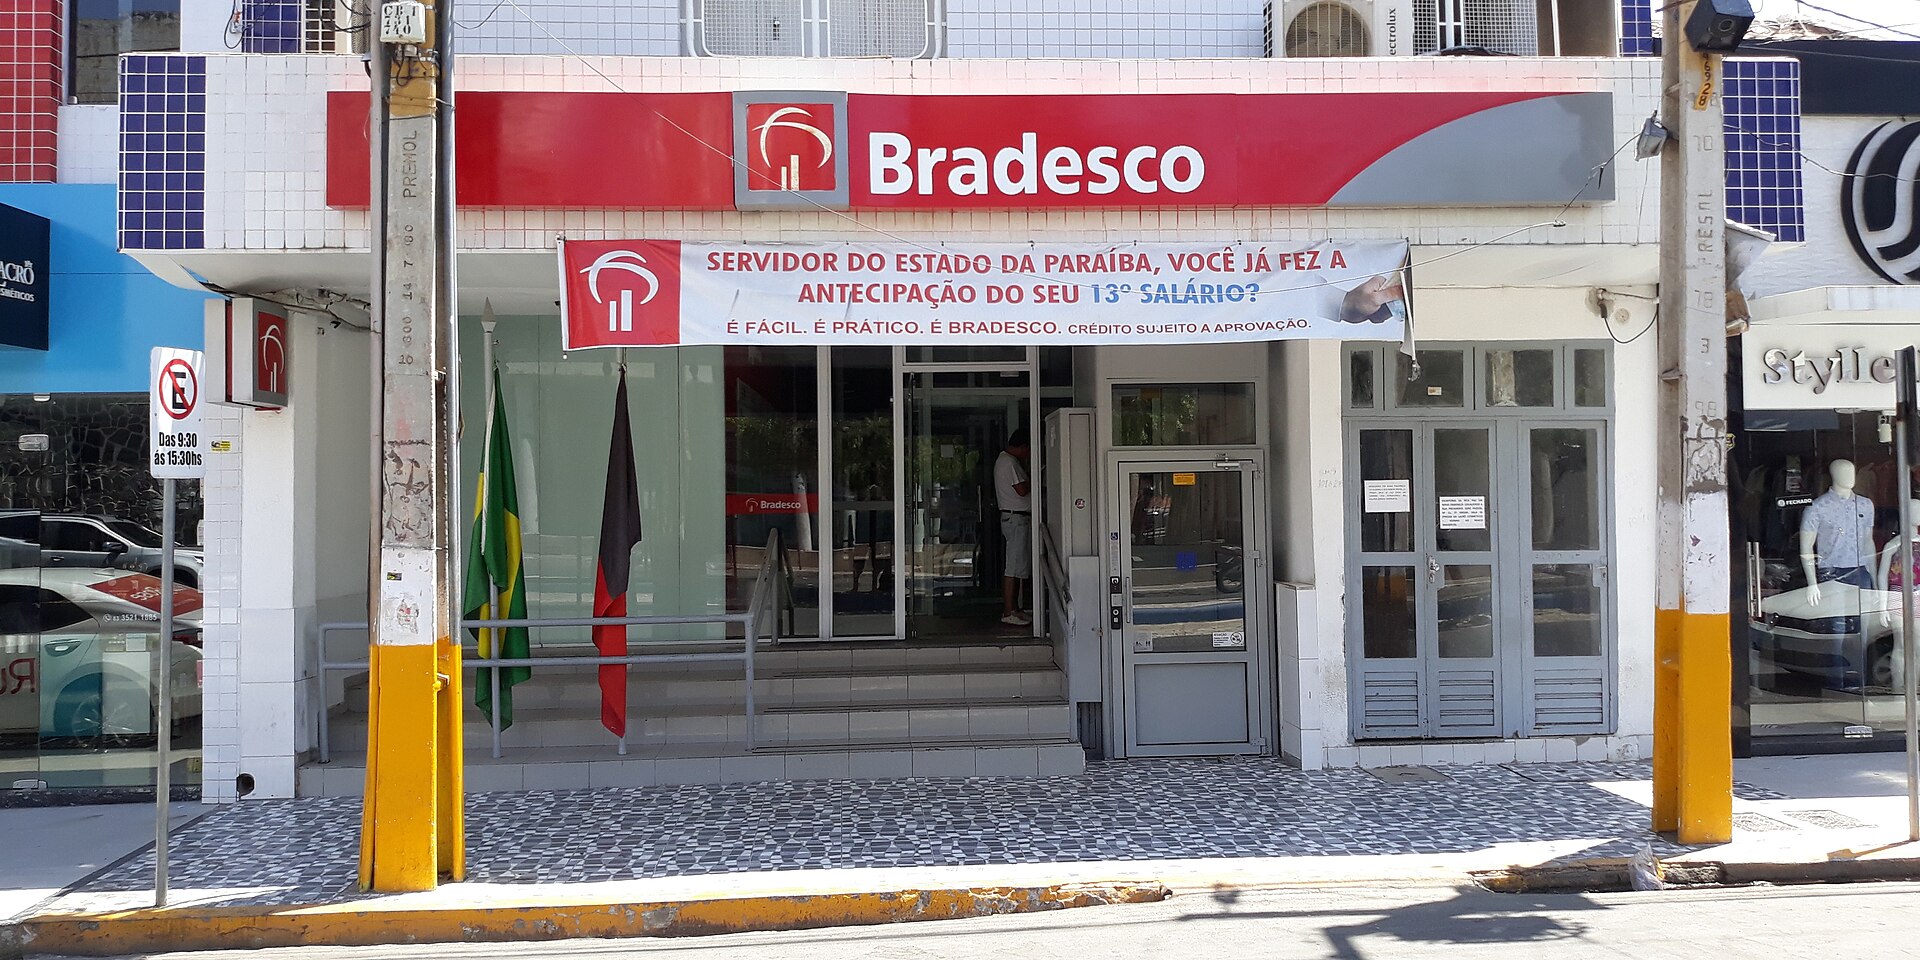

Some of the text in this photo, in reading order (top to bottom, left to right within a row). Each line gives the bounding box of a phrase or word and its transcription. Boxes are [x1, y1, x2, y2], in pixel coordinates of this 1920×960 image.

[1386, 8, 1397, 56] ectrolux
[869, 132, 1206, 196] Bradesco
[707, 246, 1348, 275] SERVIDOR DO ESTADO DA PARAÍBA, VOCÊ JÁ FEZ A
[798, 279, 977, 309] ANTECIPAÇÃO
[986, 284, 1030, 304] DO
[1033, 284, 1080, 304] SEU
[1140, 277, 1260, 304] SALÁRIO?
[727, 318, 1312, 335] É FÁCIL. É PRÁTICO. É BRADESCO. CRÉDITO SUJEITO A APROVAÇÃO.
[1763, 347, 1920, 395] Stylle
[159, 432, 176, 447] Das
[178, 433, 197, 448] 9:30
[168, 451, 202, 466] 15:30hs
[760, 500, 801, 510] Bradesco
